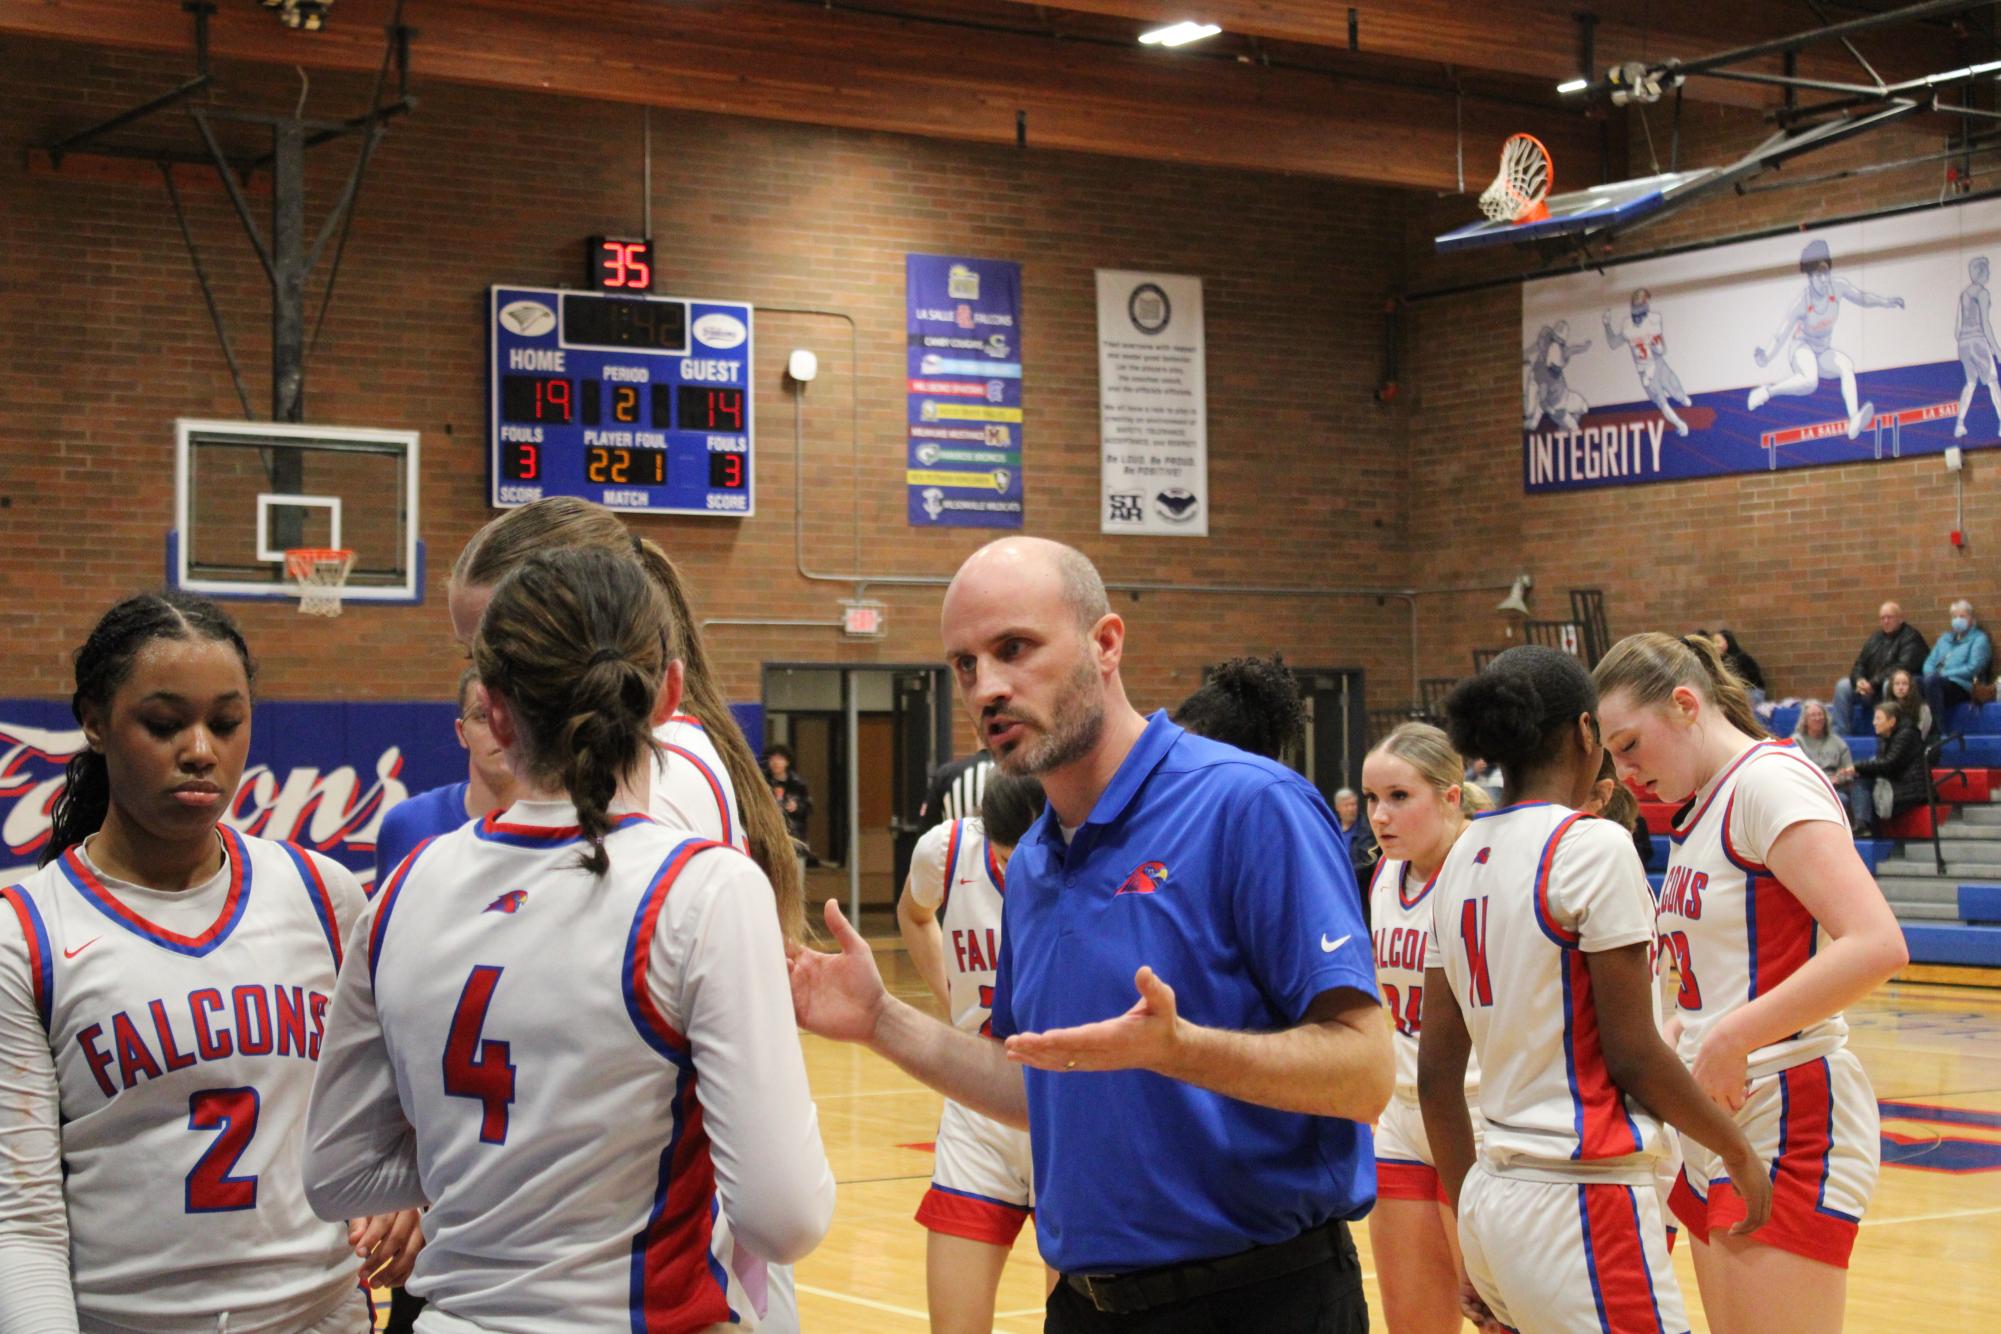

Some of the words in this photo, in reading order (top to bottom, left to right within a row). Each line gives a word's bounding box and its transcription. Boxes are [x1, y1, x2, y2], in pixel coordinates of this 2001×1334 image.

[602, 242, 650, 288] 35
[509, 348, 566, 372] HOME
[602, 365, 650, 383] PERIOD
[680, 359, 741, 382] GUEST
[535, 380, 570, 421] 19
[616, 387, 636, 421] 2
[708, 391, 742, 429] 14
[501, 426, 544, 443] FOULS
[583, 430, 633, 447] PLAYER
[635, 432, 668, 449] FOUL
[707, 435, 747, 452] FOULS
[1528, 418, 1665, 485] INTEGRITY
[519, 445, 537, 479] 3
[589, 448, 631, 483] 22
[655, 453, 663, 482] 1
[725, 453, 741, 487] 3
[500, 486, 542, 503] SCORE
[603, 490, 649, 506] MATCH
[706, 493, 747, 510] SCORE
[76, 984, 329, 1099] FALCONS
[442, 964, 517, 1146] 4
[185, 1086, 260, 1214] 2
